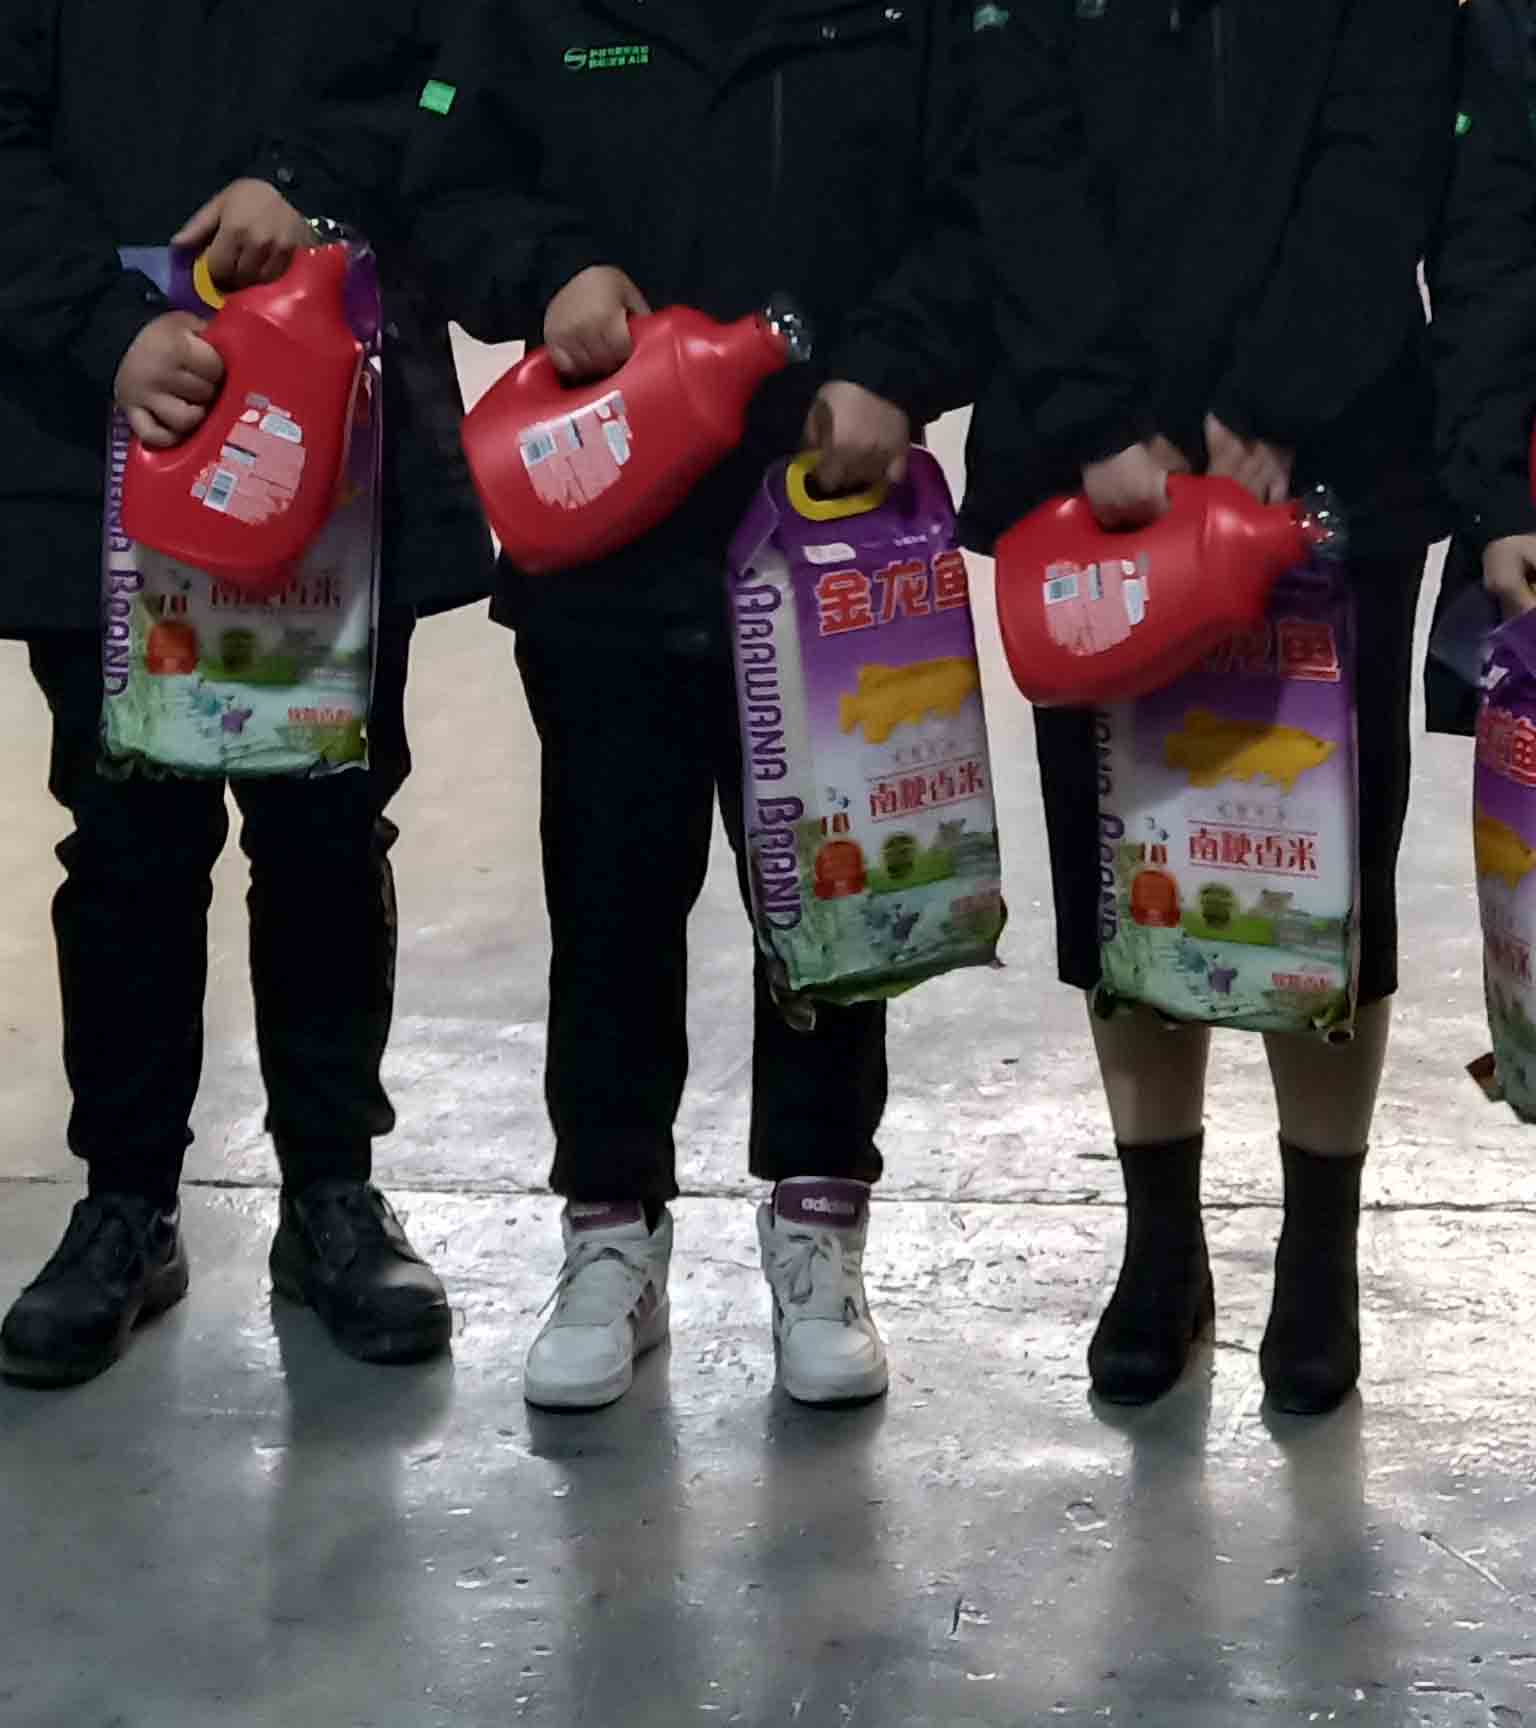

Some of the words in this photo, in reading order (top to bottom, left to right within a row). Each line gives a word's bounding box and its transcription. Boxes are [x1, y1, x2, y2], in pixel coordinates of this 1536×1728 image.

[815, 550, 968, 637] 金龙鱼
[757, 796, 804, 930] BRAND
